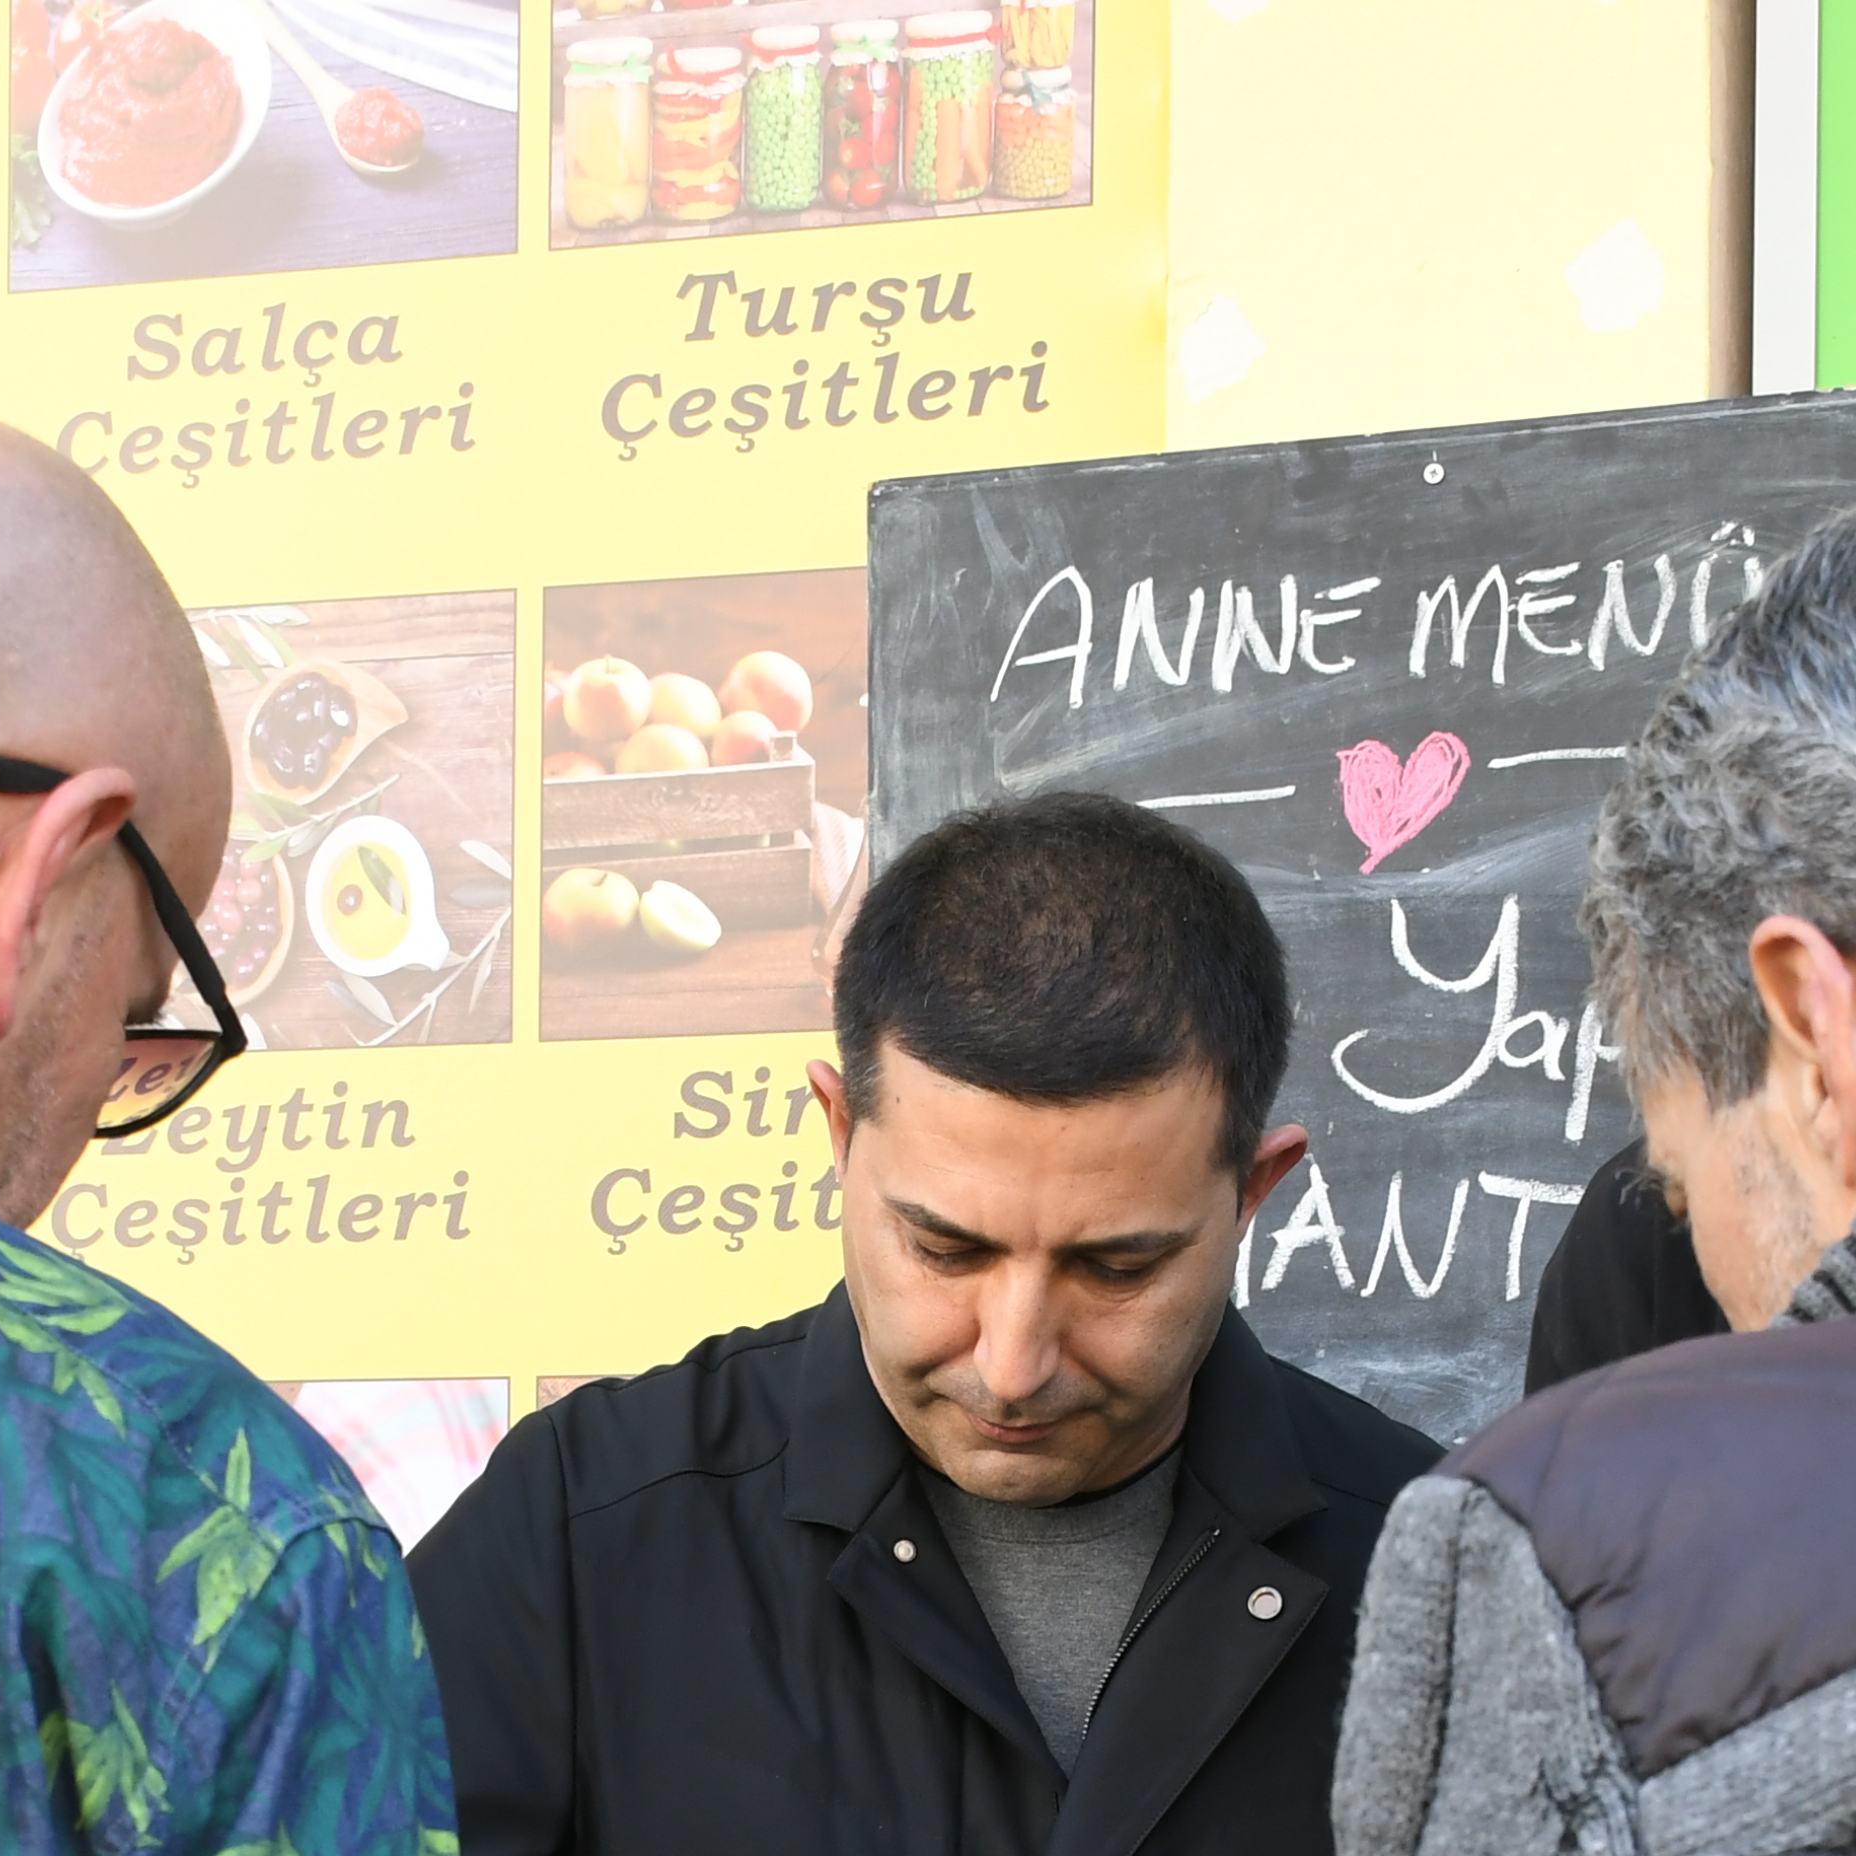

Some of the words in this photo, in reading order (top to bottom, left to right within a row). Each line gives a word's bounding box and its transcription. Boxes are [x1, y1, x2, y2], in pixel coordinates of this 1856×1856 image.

[127, 302, 404, 388] Salça
[676, 269, 976, 347] Turşu
[602, 341, 1051, 463] Çeşitleri
[990, 566, 1382, 709] ANNE
[52, 1168, 472, 1265] Çeşitleri
[1231, 1153, 1586, 1310] ANT
